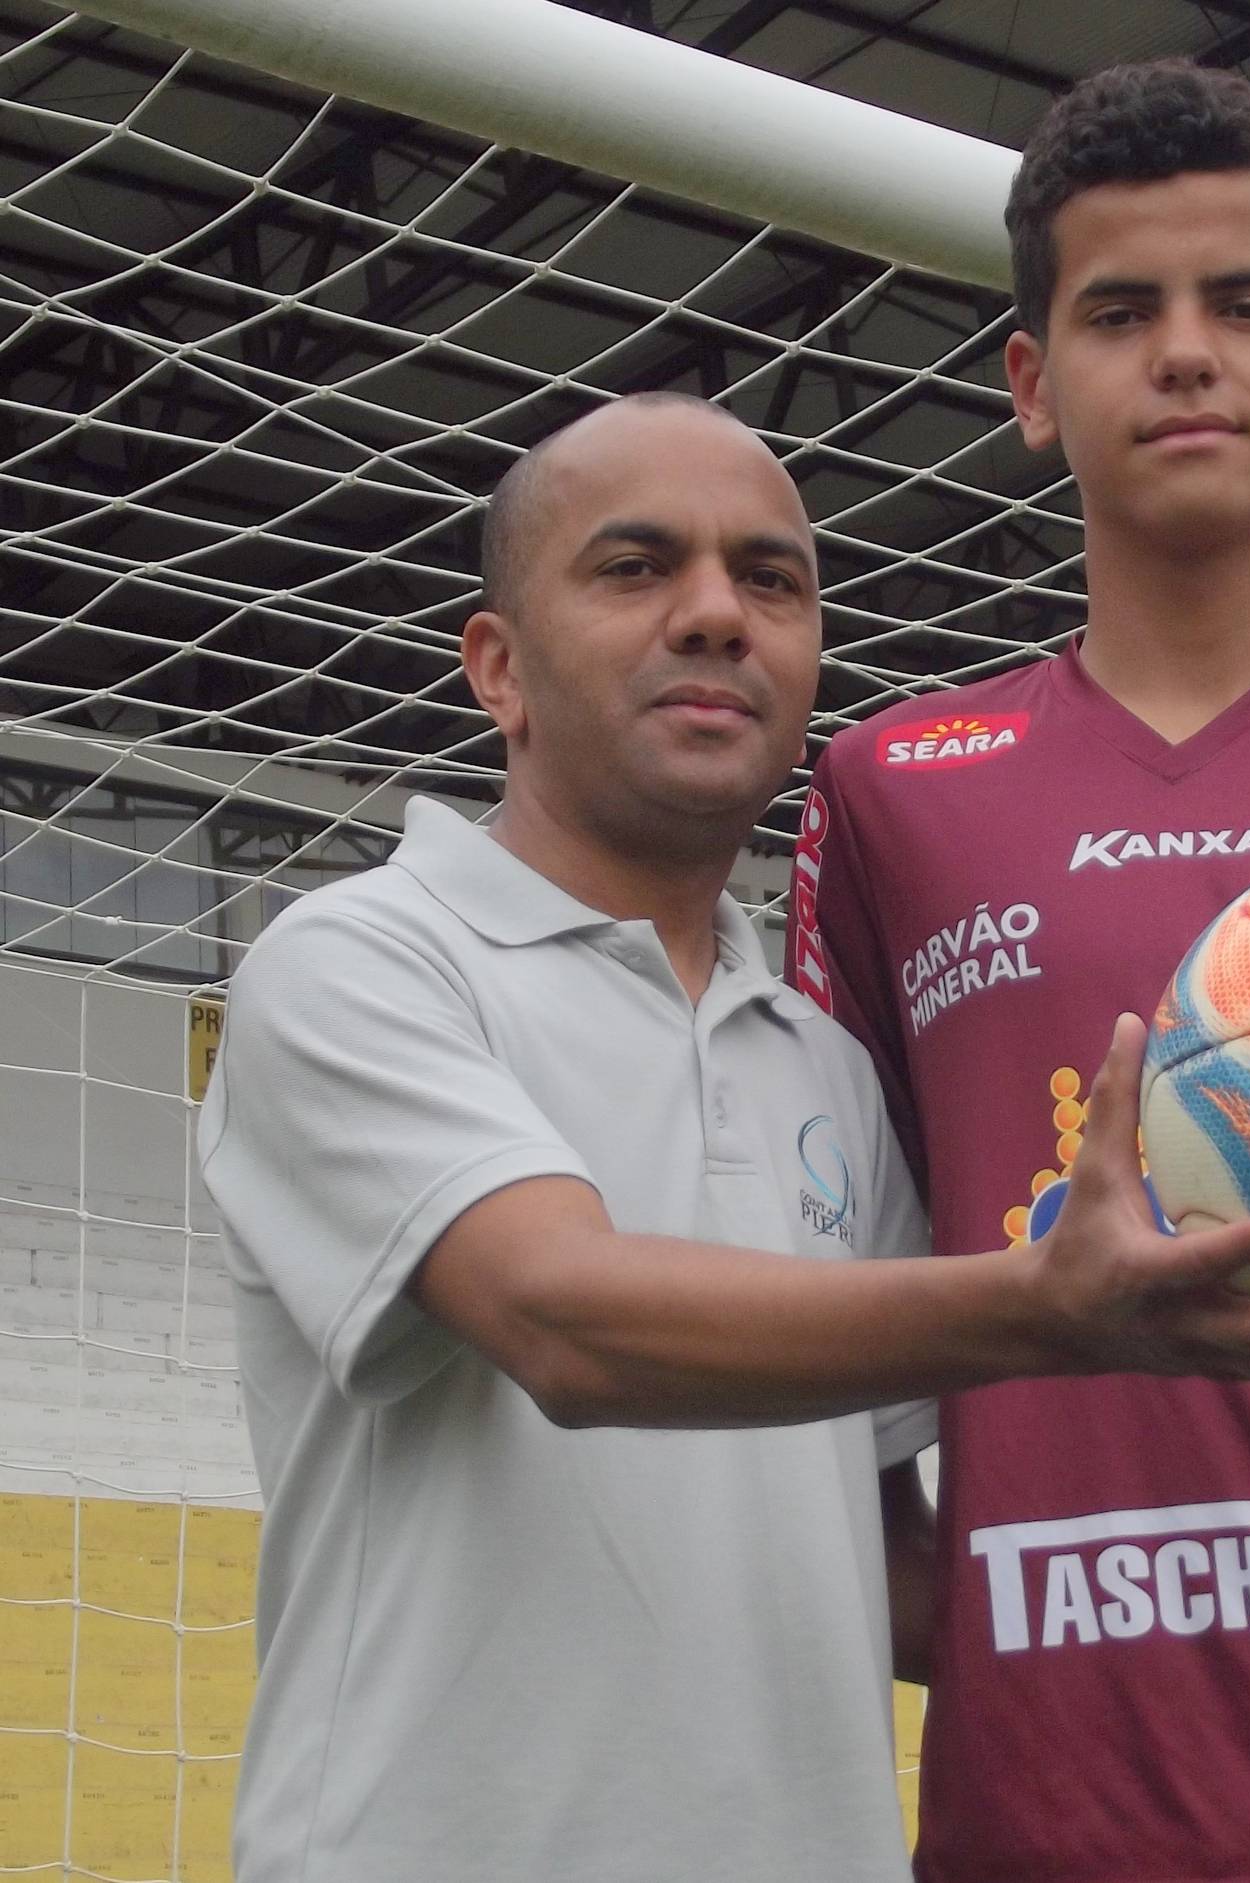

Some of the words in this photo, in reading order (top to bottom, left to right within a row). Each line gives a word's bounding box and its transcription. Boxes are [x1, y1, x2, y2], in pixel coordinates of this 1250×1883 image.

[886, 728, 1018, 763] SEARA
[902, 900, 1040, 998] CARVÃO
[191, 1005, 225, 1034] PR
[909, 943, 1043, 1037] MINERAL
